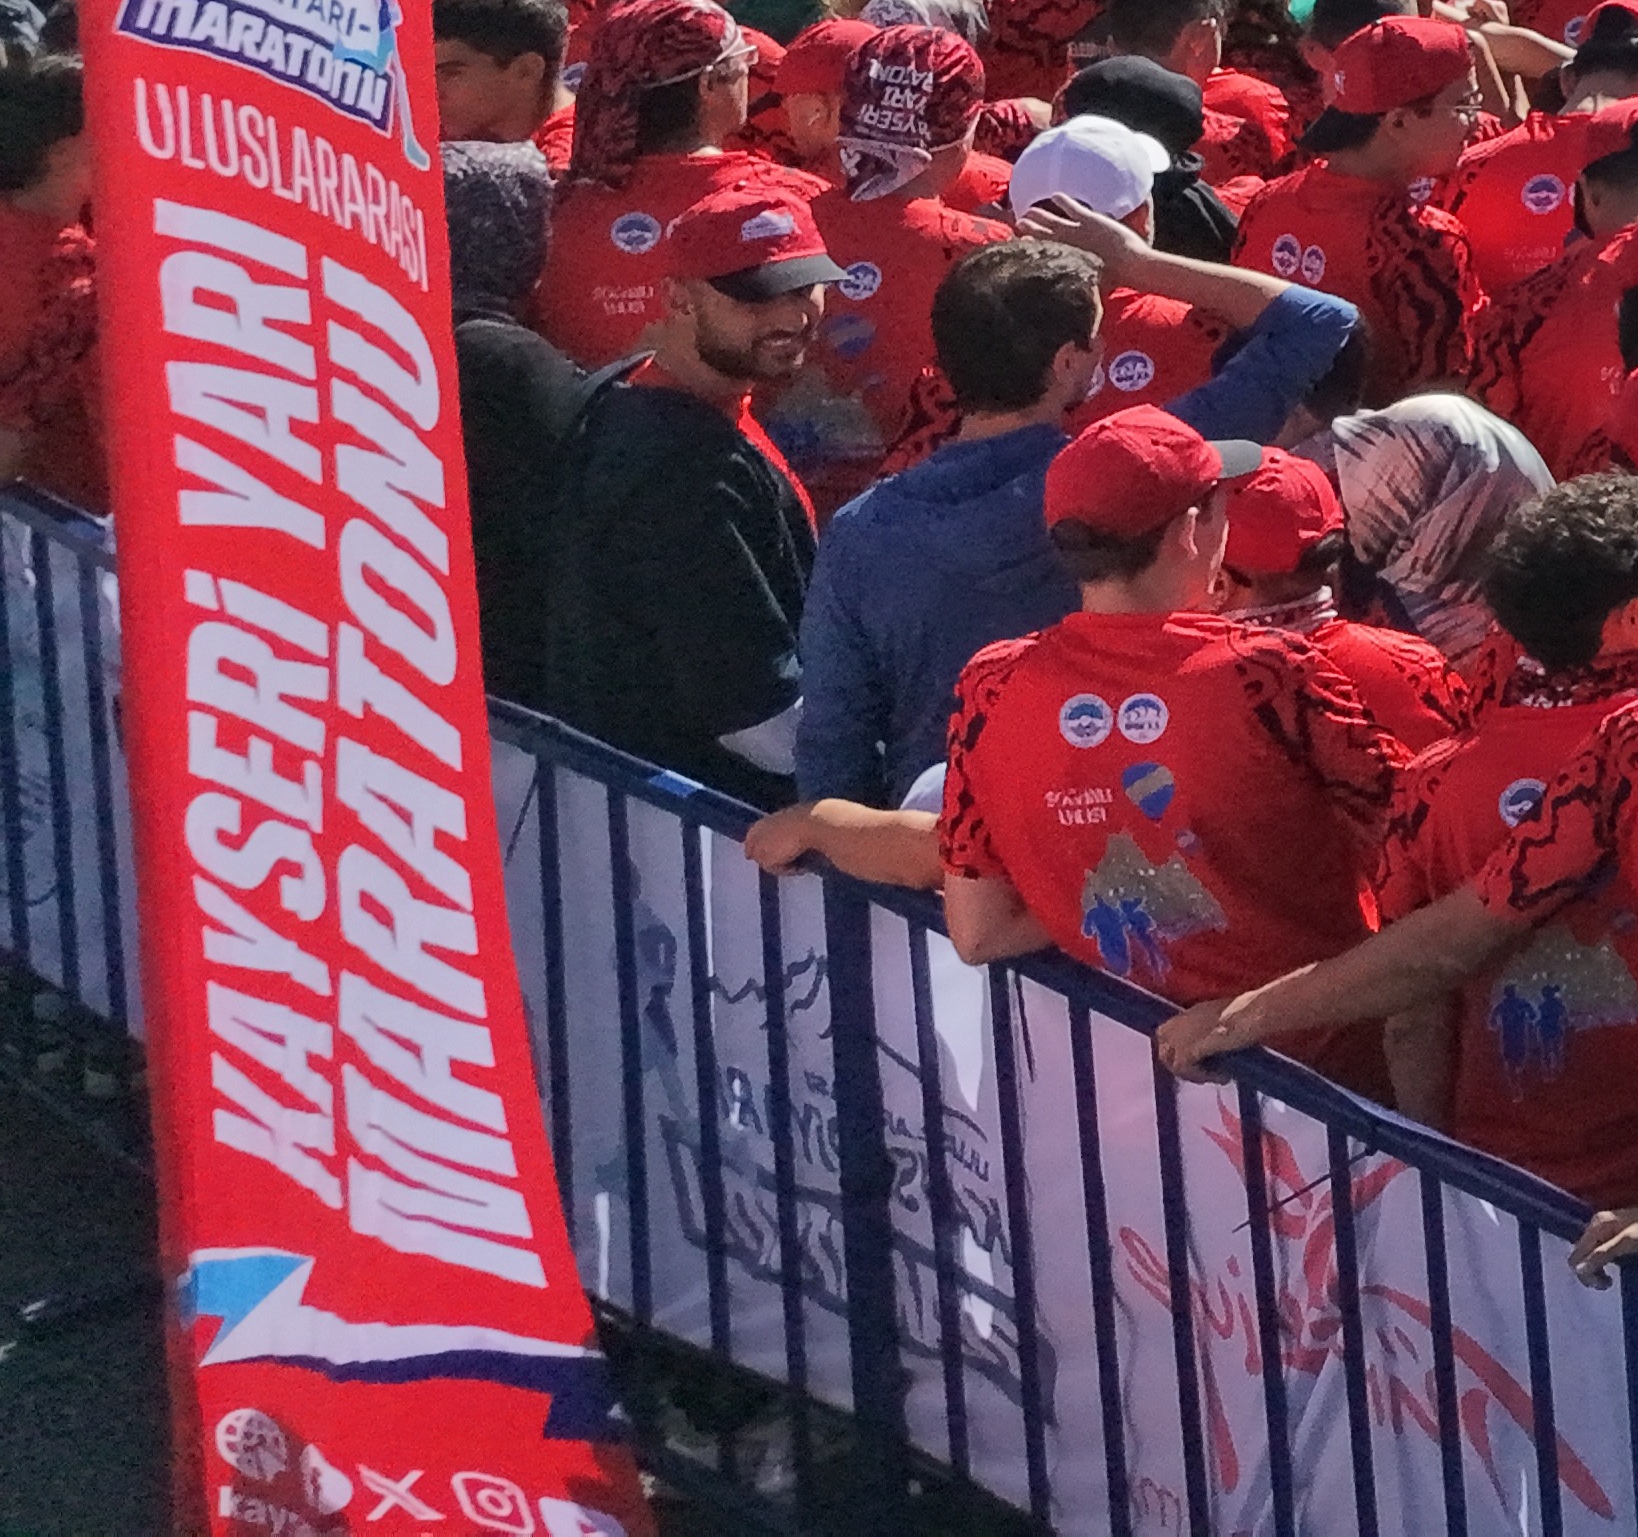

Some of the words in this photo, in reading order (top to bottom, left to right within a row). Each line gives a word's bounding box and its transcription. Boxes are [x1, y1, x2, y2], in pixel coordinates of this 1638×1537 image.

[131, 76, 430, 293] ULUSLARARASI
[153, 197, 328, 551] YARI
[184, 568, 345, 1211] KAYSERİ
[320, 254, 549, 1290] MARATONU
